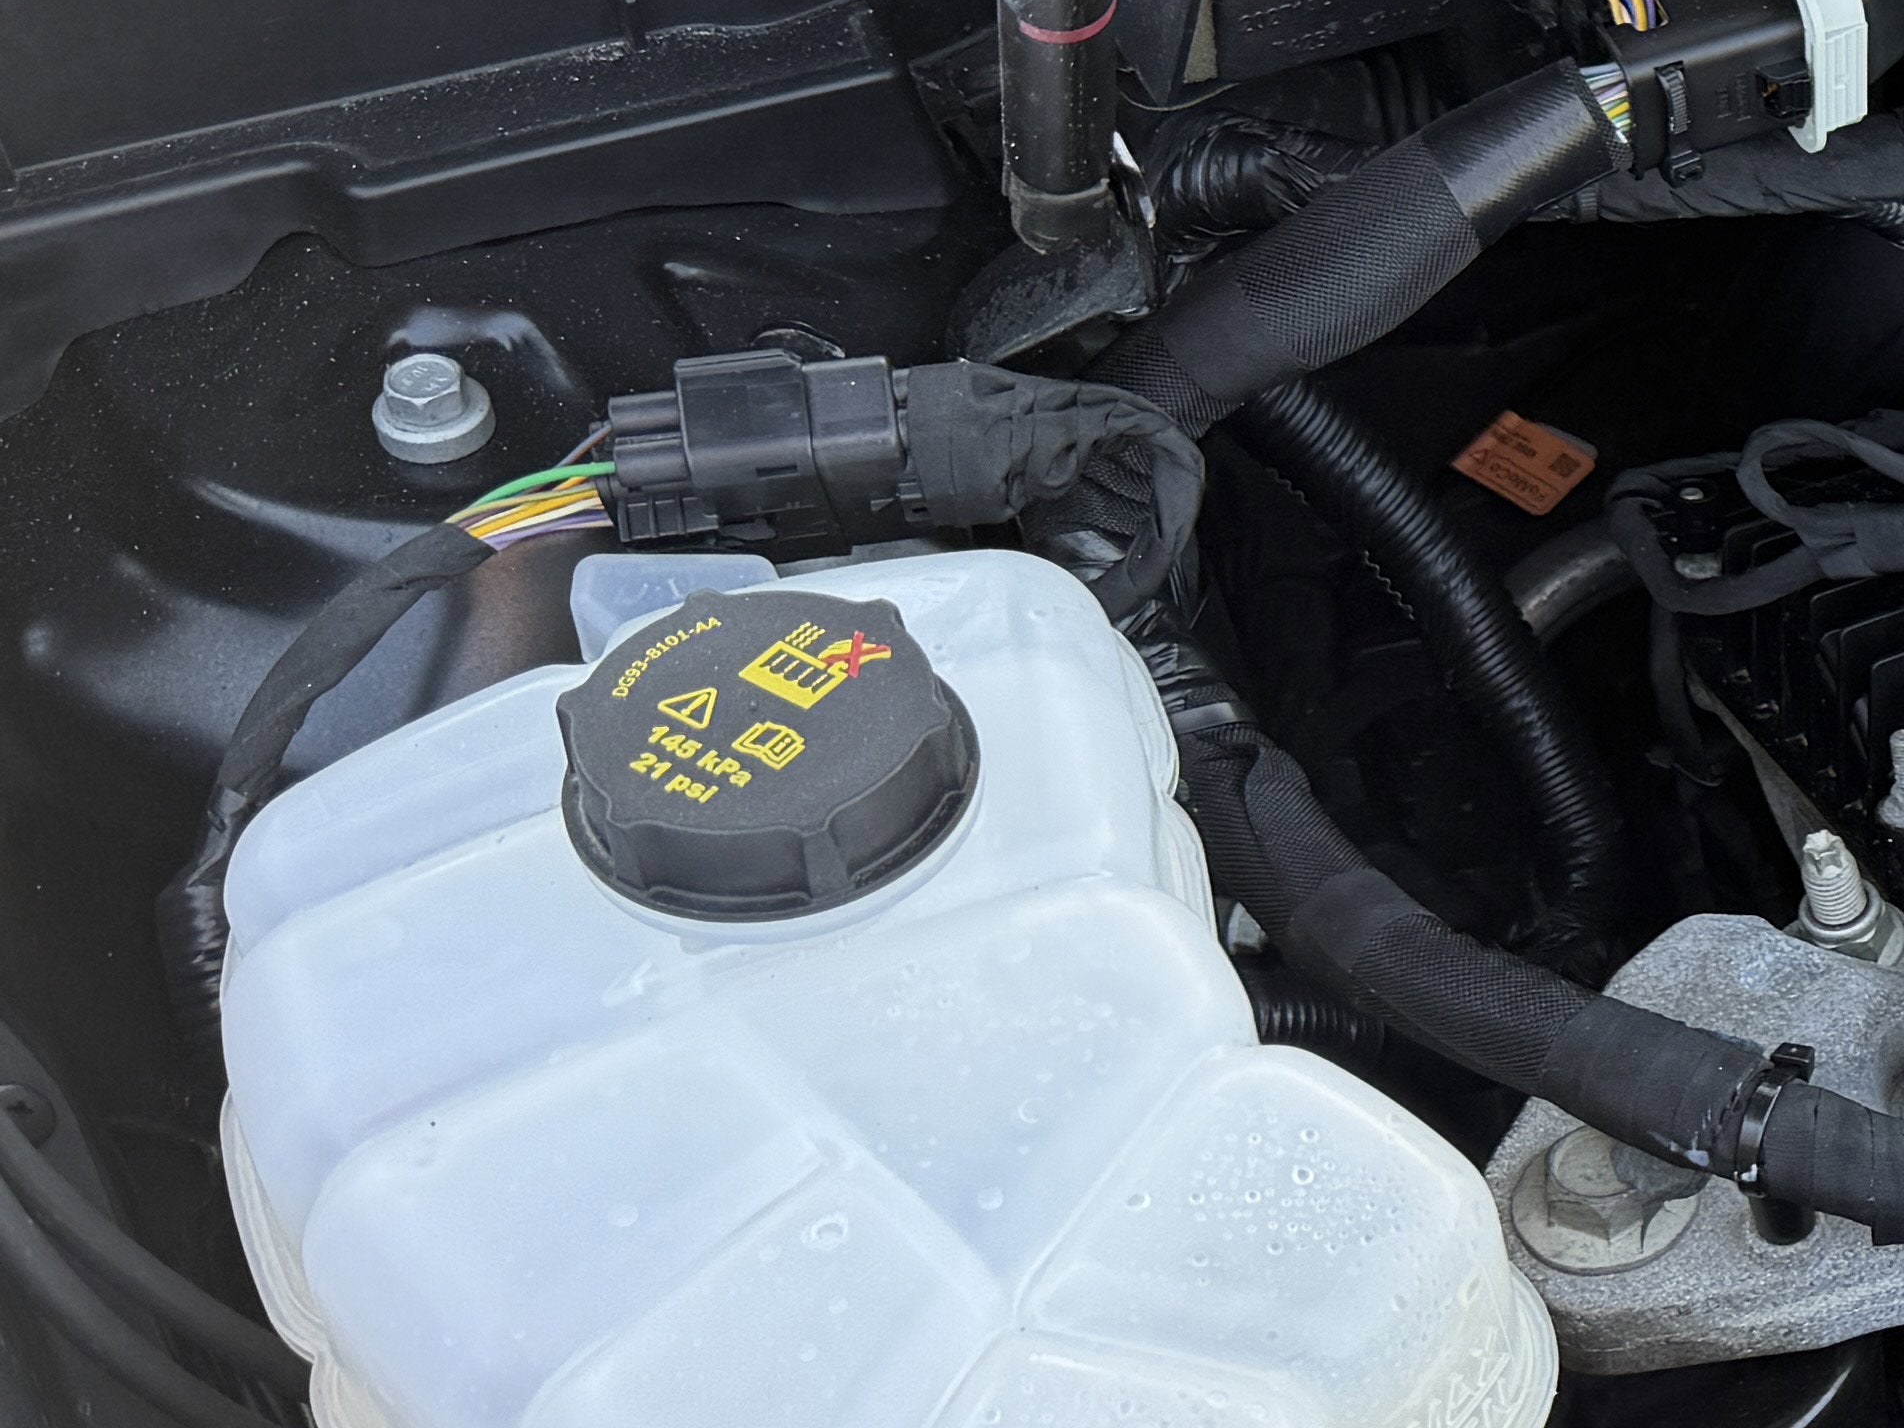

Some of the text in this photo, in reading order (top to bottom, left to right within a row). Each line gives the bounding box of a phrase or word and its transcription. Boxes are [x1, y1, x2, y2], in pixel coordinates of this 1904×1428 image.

[612, 616, 722, 699] DG93-8101-AA
[630, 753, 719, 804] 21 psi
[647, 725, 752, 788] 145 kPa
